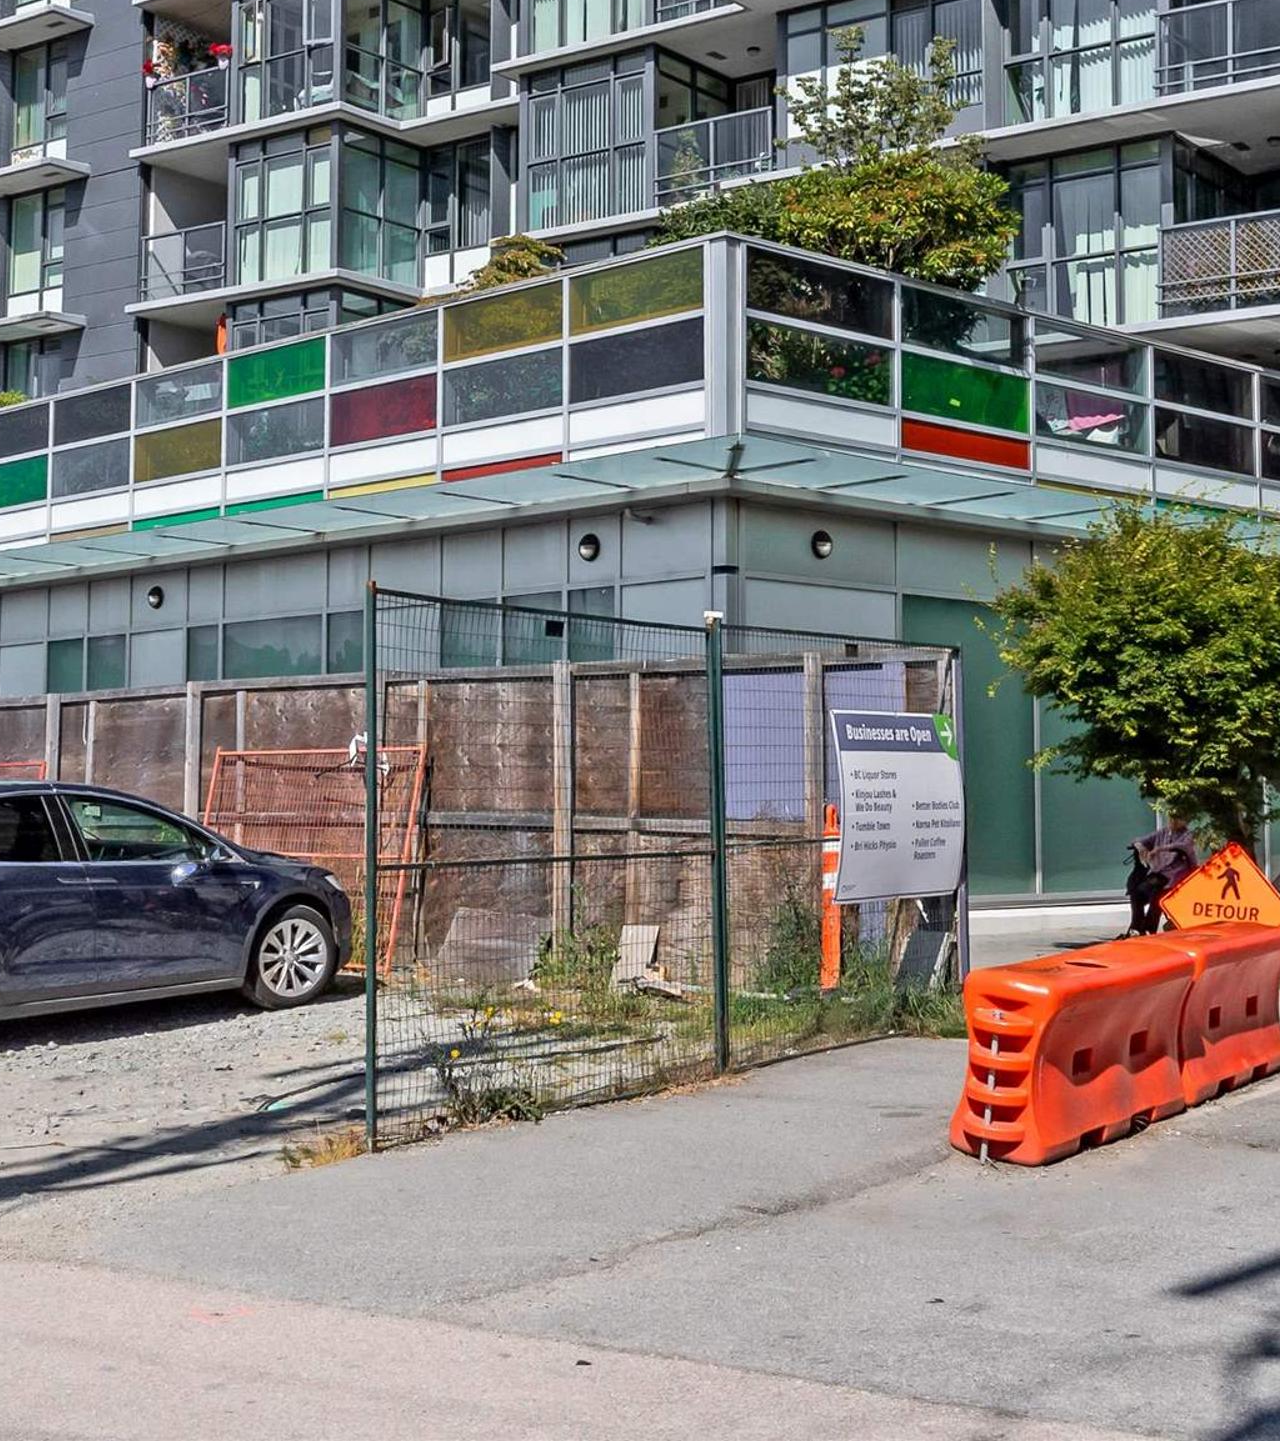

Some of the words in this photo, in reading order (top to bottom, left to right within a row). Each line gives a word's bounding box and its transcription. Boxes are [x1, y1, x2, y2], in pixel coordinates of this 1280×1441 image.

[846, 724, 894, 741] Businesses
[895, 729, 909, 742] are
[910, 726, 932, 746] Open
[863, 770, 879, 782] Liquor
[873, 802, 892, 814] Beauty
[931, 800, 948, 810] Bodies
[949, 800, 960, 810] Club
[931, 819, 940, 828] Pet
[1192, 902, 1260, 921] DETOUR
